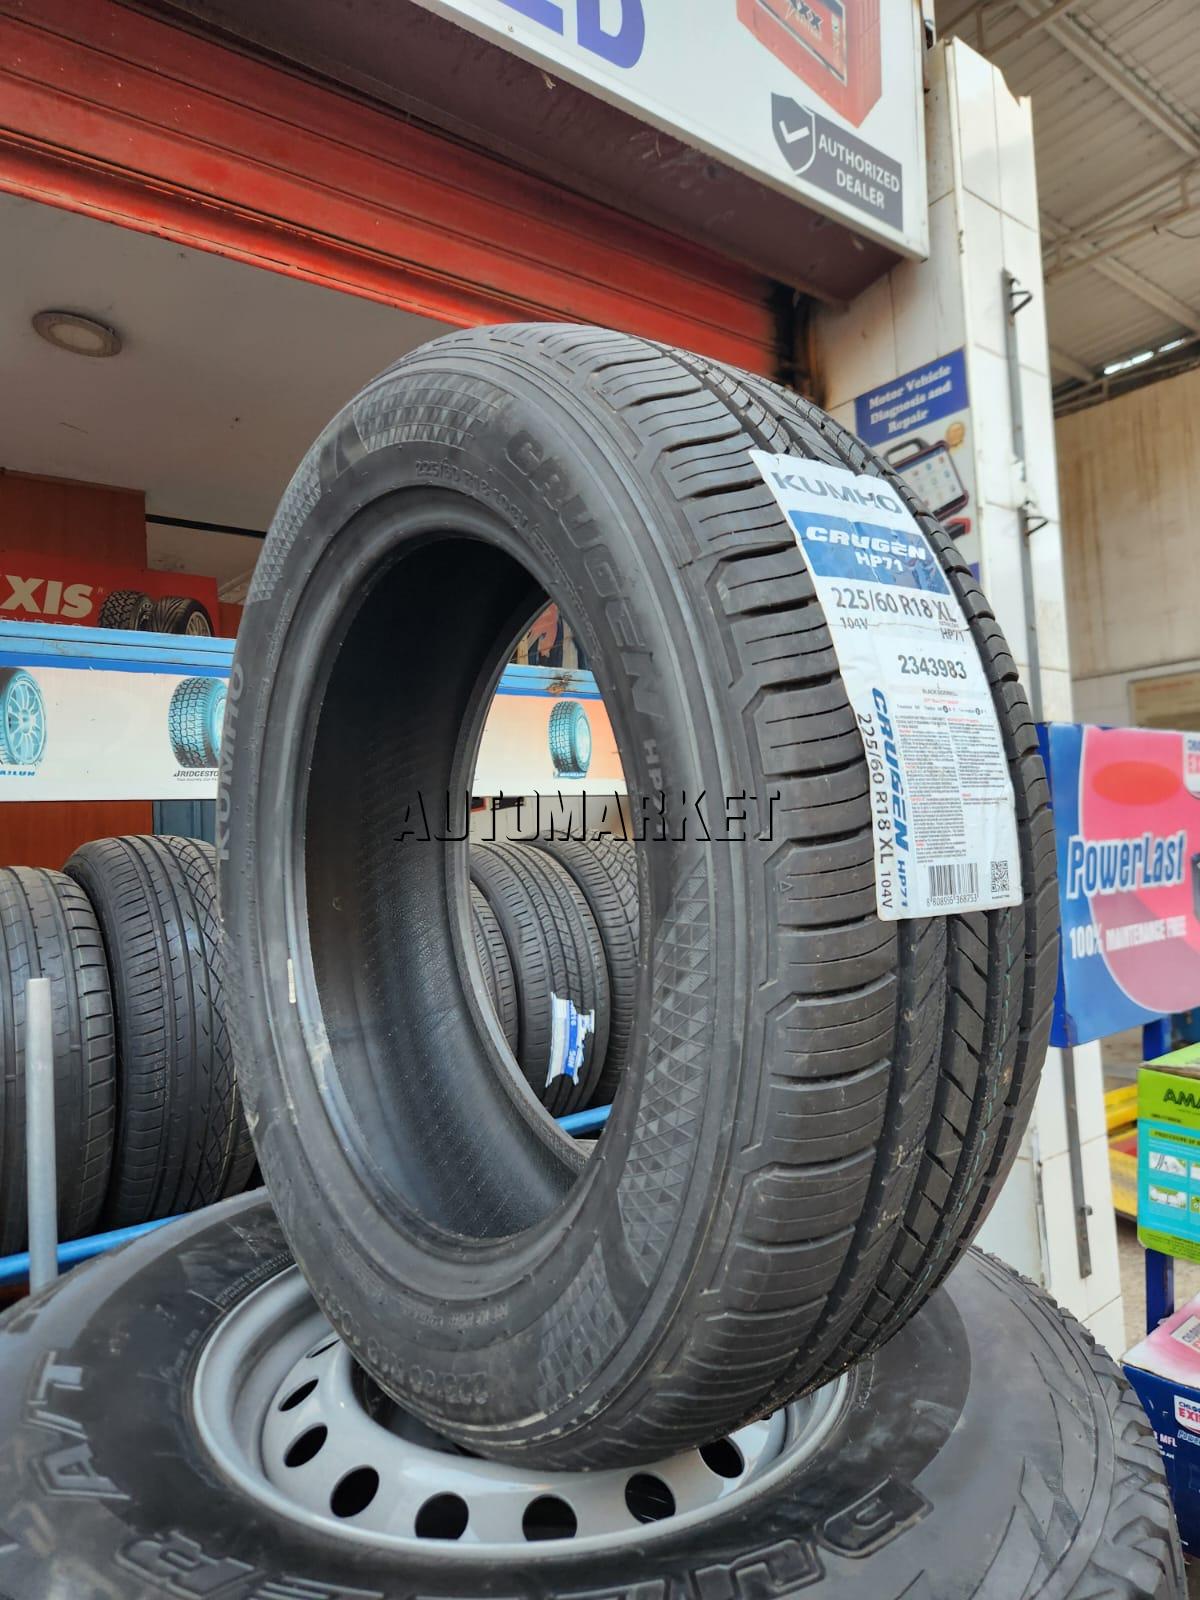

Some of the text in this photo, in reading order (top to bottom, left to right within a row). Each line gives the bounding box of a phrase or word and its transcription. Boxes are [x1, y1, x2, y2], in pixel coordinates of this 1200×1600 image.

[818, 133, 900, 192] AUTHORIZED
[836, 168, 885, 209] DEALER
[905, 365, 951, 392] Vehicle
[928, 379, 952, 400] and
[888, 408, 929, 433] Repair
[771, 472, 903, 514] KUMHO
[805, 526, 926, 560] CRUGEN
[854, 551, 904, 572] HP71
[831, 587, 957, 622] 225/60 R18 XL
[840, 616, 869, 630] 104V
[898, 654, 967, 679] 2343983
[872, 687, 909, 852] CRUGEN
[857, 713, 894, 908] 225/60 R18 XL 104V
